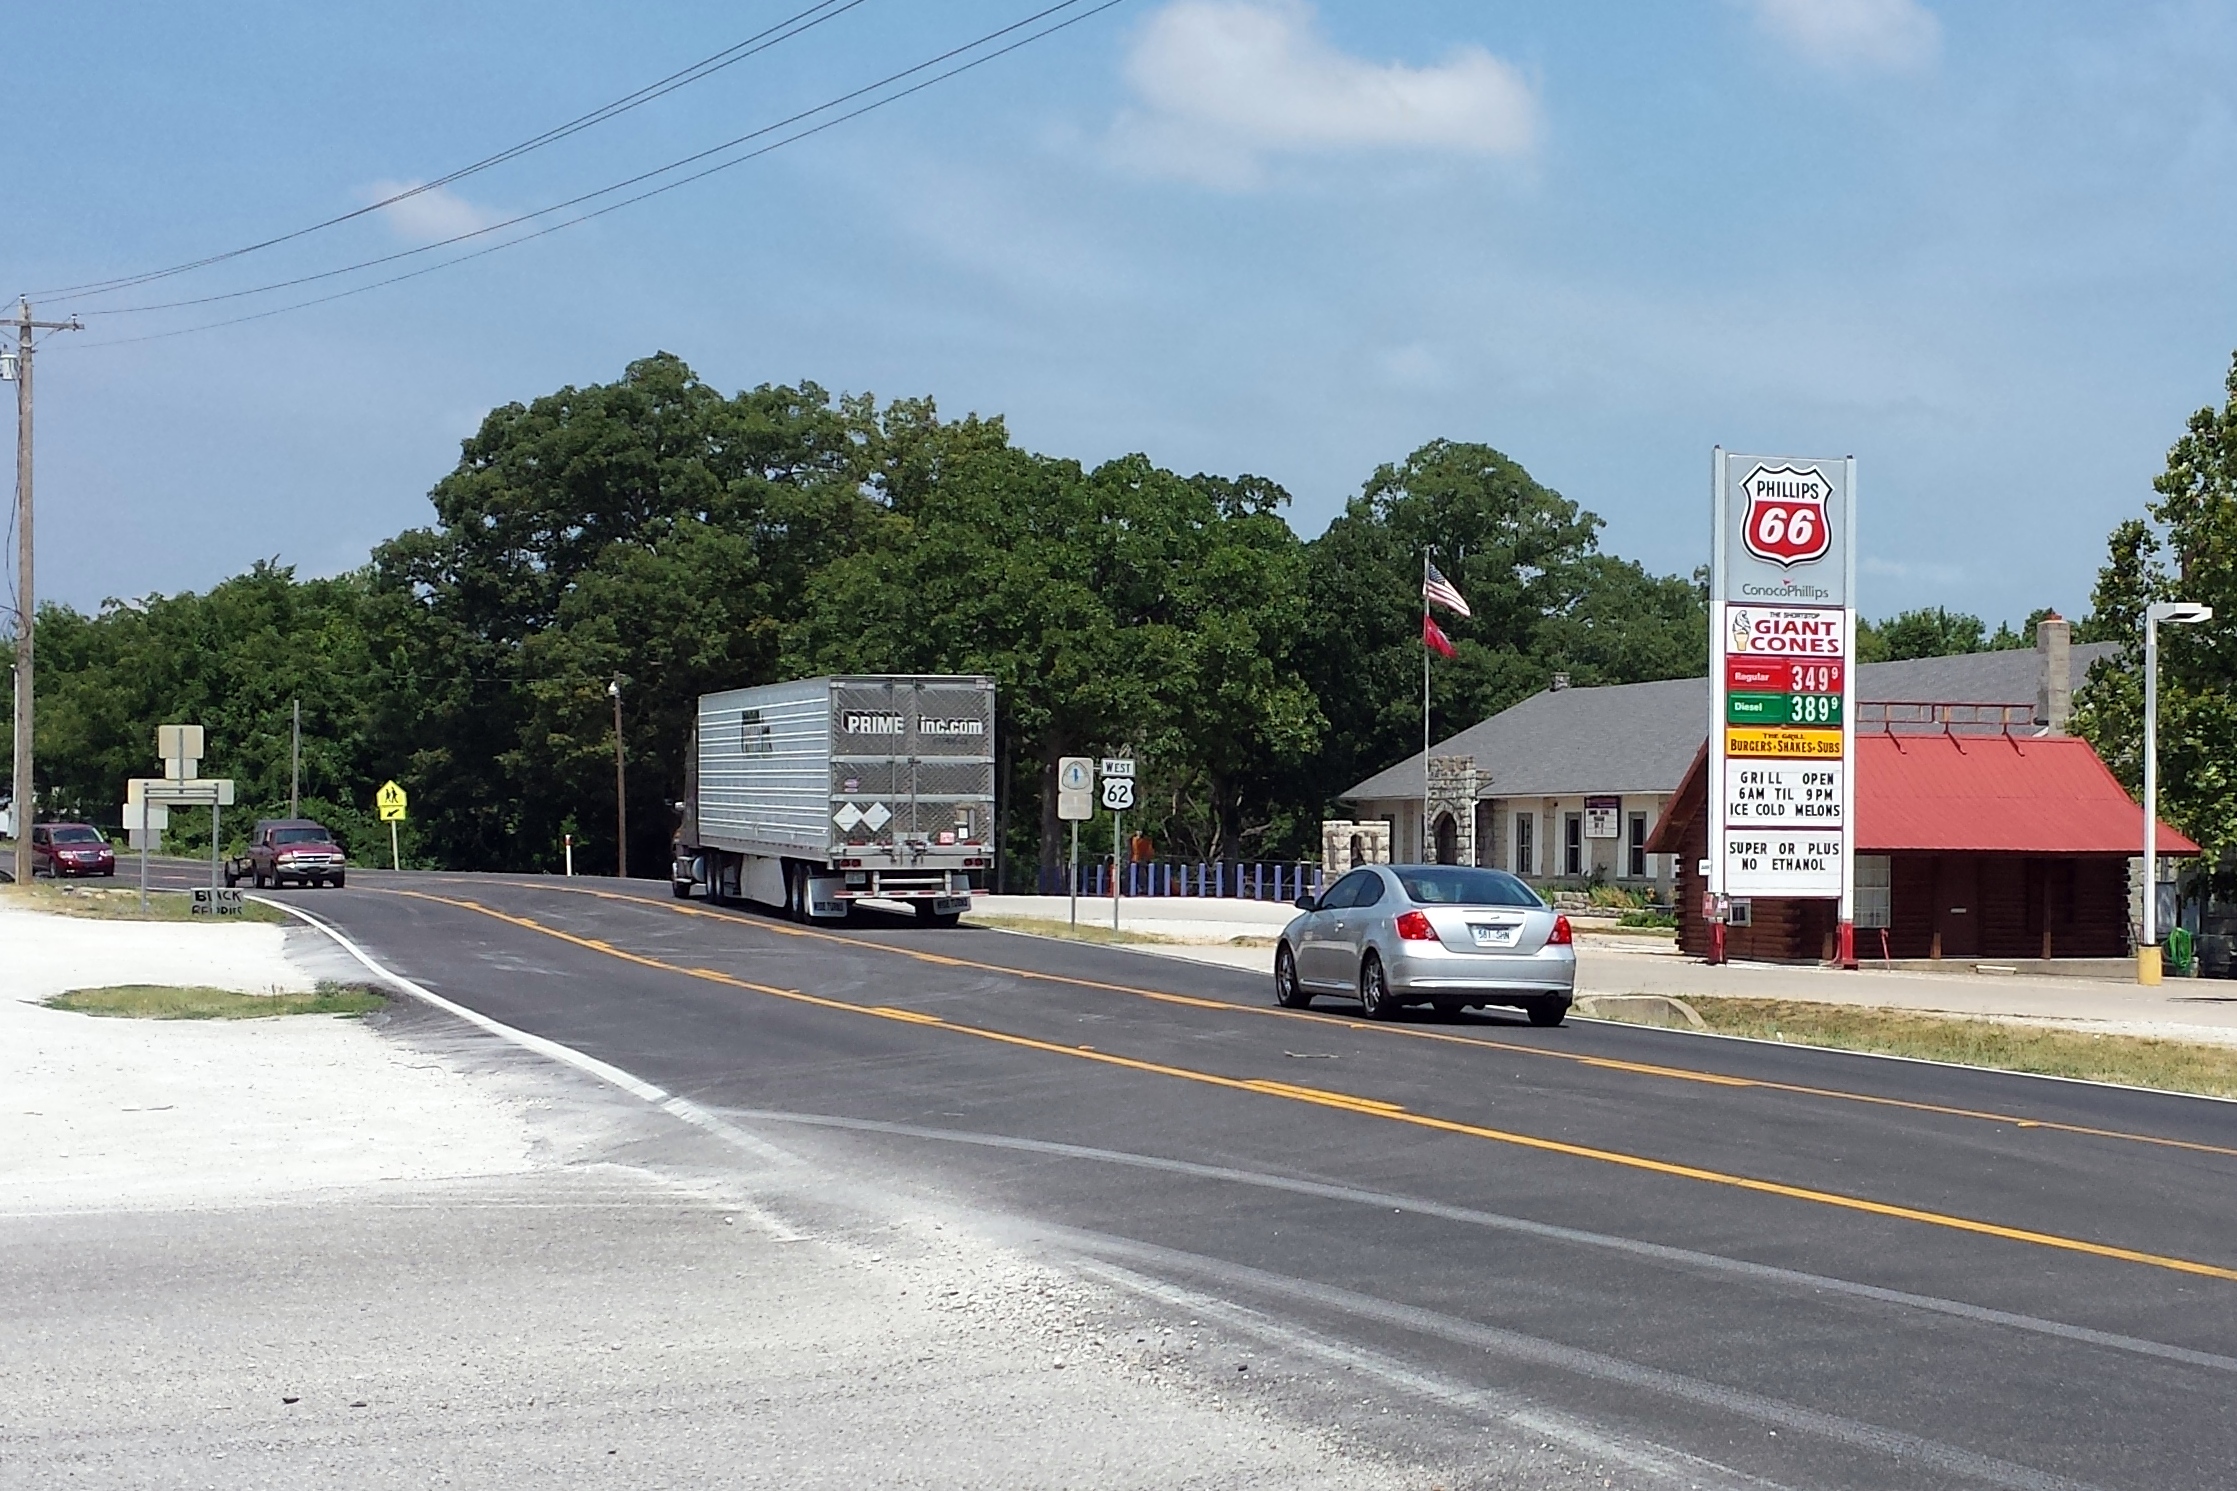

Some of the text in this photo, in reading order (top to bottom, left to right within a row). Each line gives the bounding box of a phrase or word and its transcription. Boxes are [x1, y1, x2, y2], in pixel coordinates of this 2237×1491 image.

[1757, 481, 1819, 499] PHILLIPS
[1759, 507, 1816, 545] 66
[1742, 583, 1829, 600] ConocoPhillips
[1755, 620, 1836, 636] GIANT
[1750, 637, 1839, 653] CONES
[1735, 672, 1770, 682] Regular
[1734, 702, 1763, 711] Diesel
[846, 713, 983, 735] PRIME inc.com
[1106, 762, 1131, 773] WEST
[1740, 771, 1834, 785] GRILL OPEN
[1108, 785, 1128, 803] 62
[1739, 787, 1833, 801] 6AM TIL 9PM
[1730, 803, 1840, 817] ICE COLD MELONS
[1729, 842, 1840, 855] SUPER OR PLUS
[1742, 858, 1826, 871] NO ETHANOL
